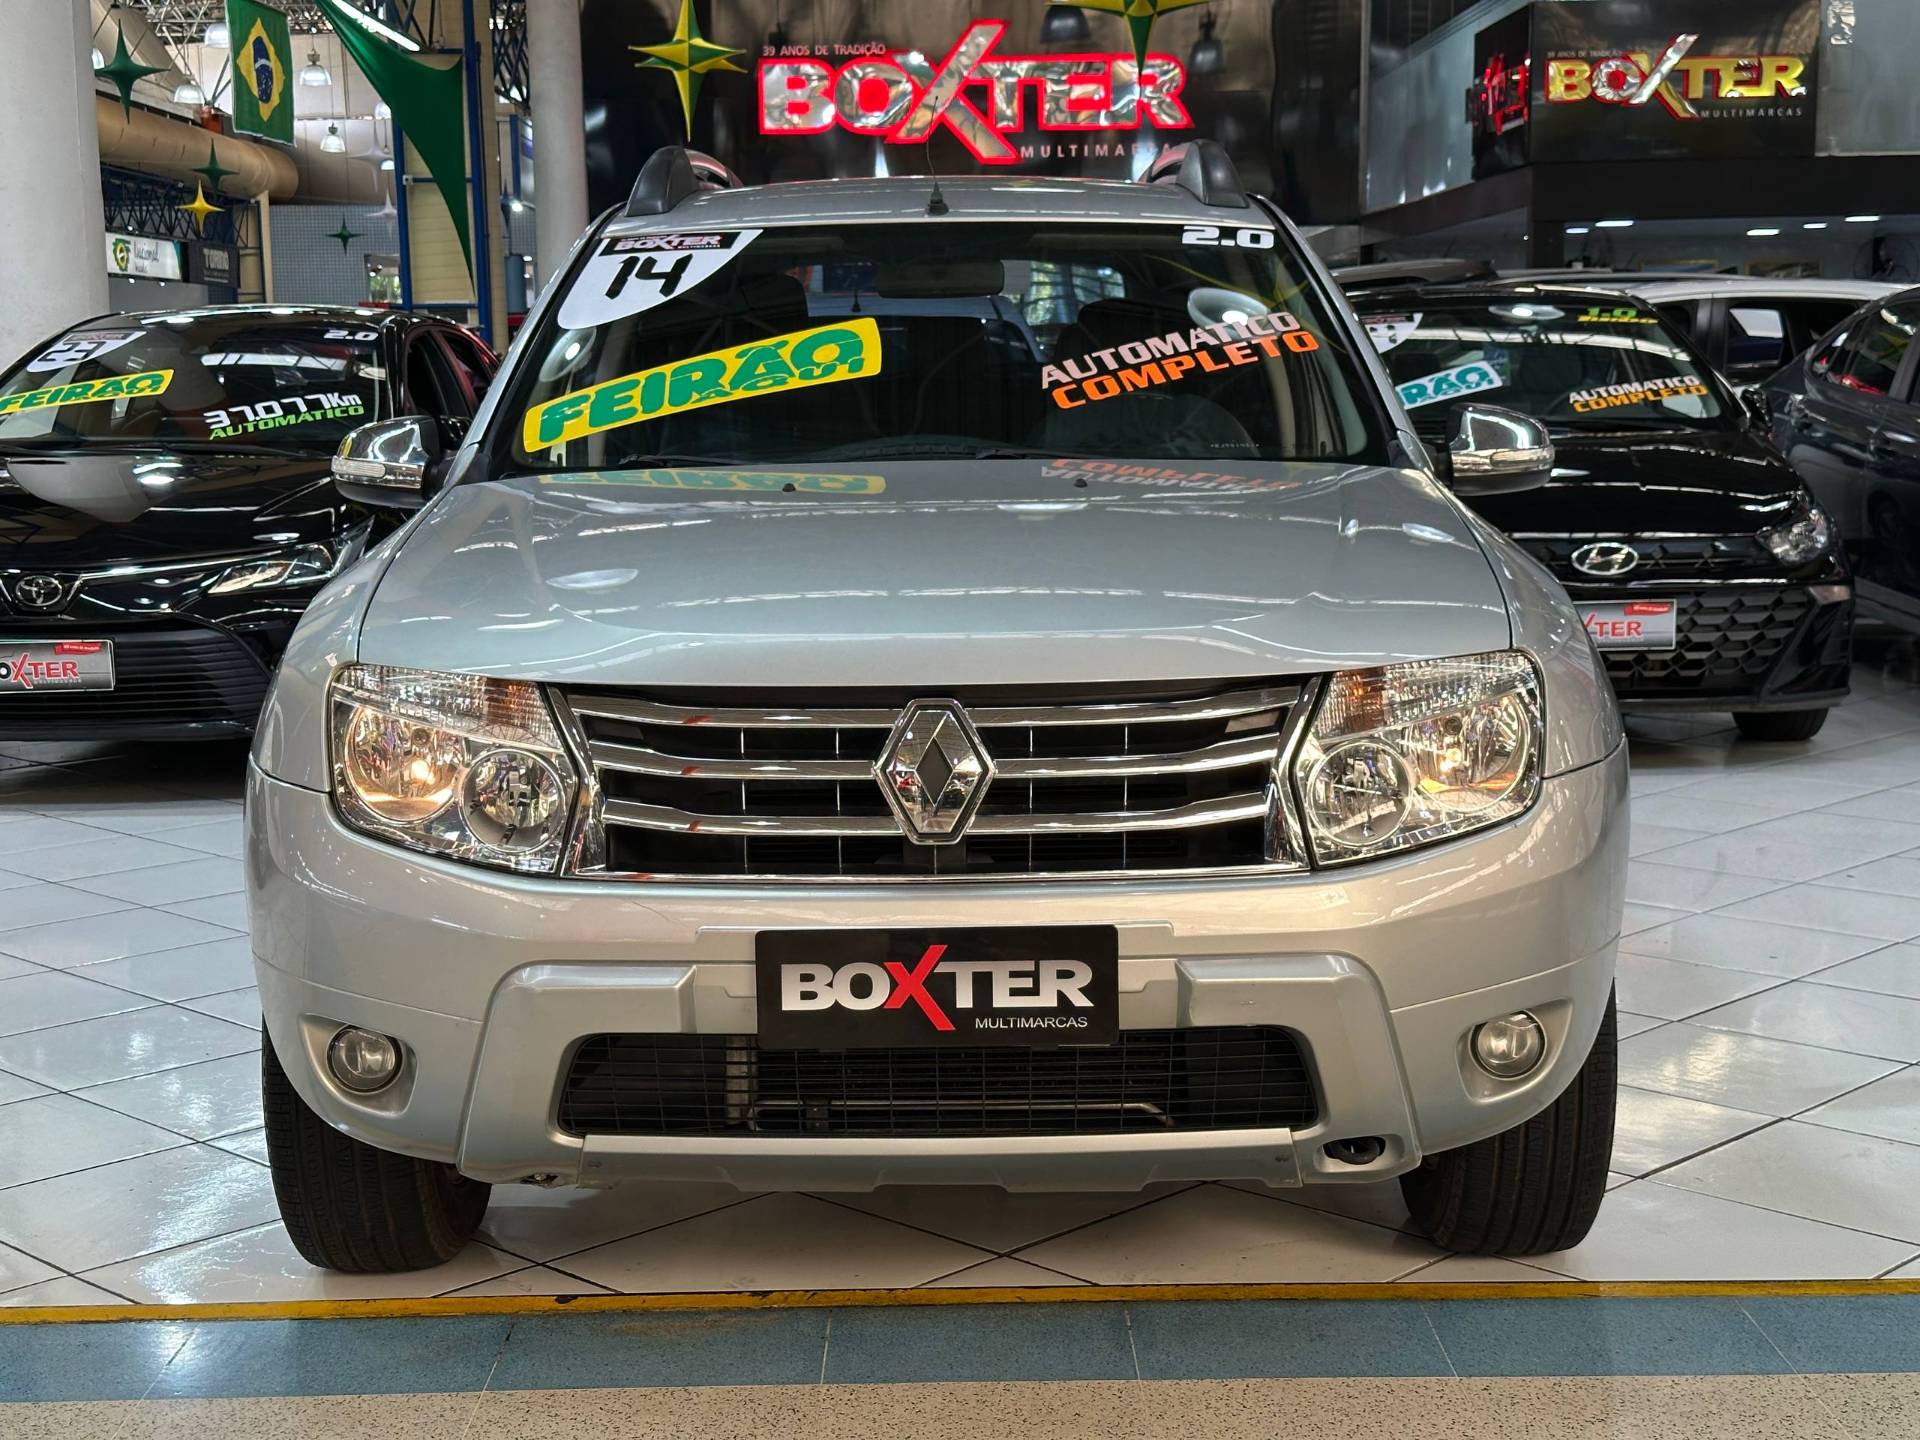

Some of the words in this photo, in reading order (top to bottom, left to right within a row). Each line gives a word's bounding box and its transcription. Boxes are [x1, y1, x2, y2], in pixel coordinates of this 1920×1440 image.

[762, 46, 775, 57] 39
[780, 45, 809, 56] ANOS
[815, 45, 828, 56] DE
[834, 42, 886, 56] TRADIÇÃO
[758, 19, 1195, 165] BOXTER
[1544, 33, 1808, 121] BOXTER
[1701, 107, 1803, 119] MULTIMARCAS
[613, 234, 722, 251] BOXTER
[1182, 225, 1275, 249] 2.0
[605, 253, 693, 300] 14
[323, 329, 379, 341] 2.0
[1042, 311, 1301, 389] AUTOMATICO
[538, 328, 865, 443] FEIRÃO
[1052, 331, 1320, 410] COMPLETO
[1400, 366, 1491, 405] RÃO
[1569, 374, 1701, 404] AUTOMATICO
[1573, 384, 1710, 413] COMPLETO
[203, 392, 363, 429] 37.077Km
[209, 405, 365, 440] AUTOMATICO
[0, 653, 80, 689] OXTER
[781, 944, 1095, 1031] BOXTER
[975, 1016, 1088, 1029] MULTIMARCAS
